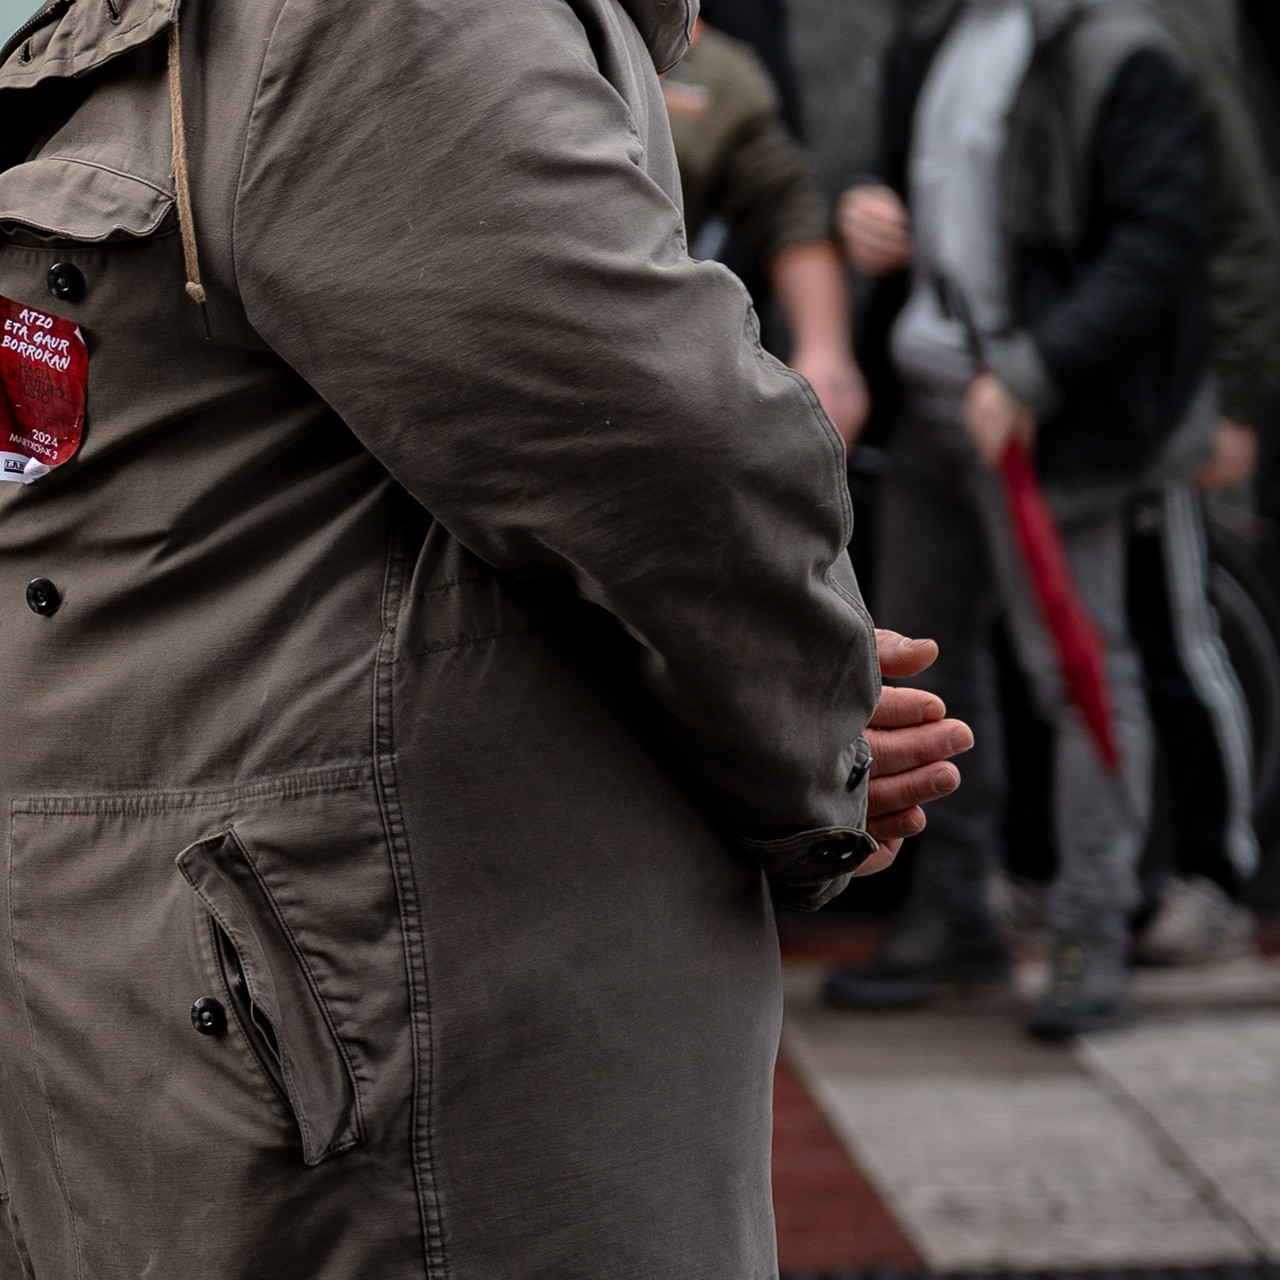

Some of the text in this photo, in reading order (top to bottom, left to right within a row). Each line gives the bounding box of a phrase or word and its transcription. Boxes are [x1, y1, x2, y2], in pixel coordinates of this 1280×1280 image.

[19, 308, 53, 329] ATZO
[4, 319, 70, 356] ETA GAUR
[0, 335, 70, 372] BORROKAN
[32, 428, 58, 447] 2024
[51, 450, 58, 460] 3
